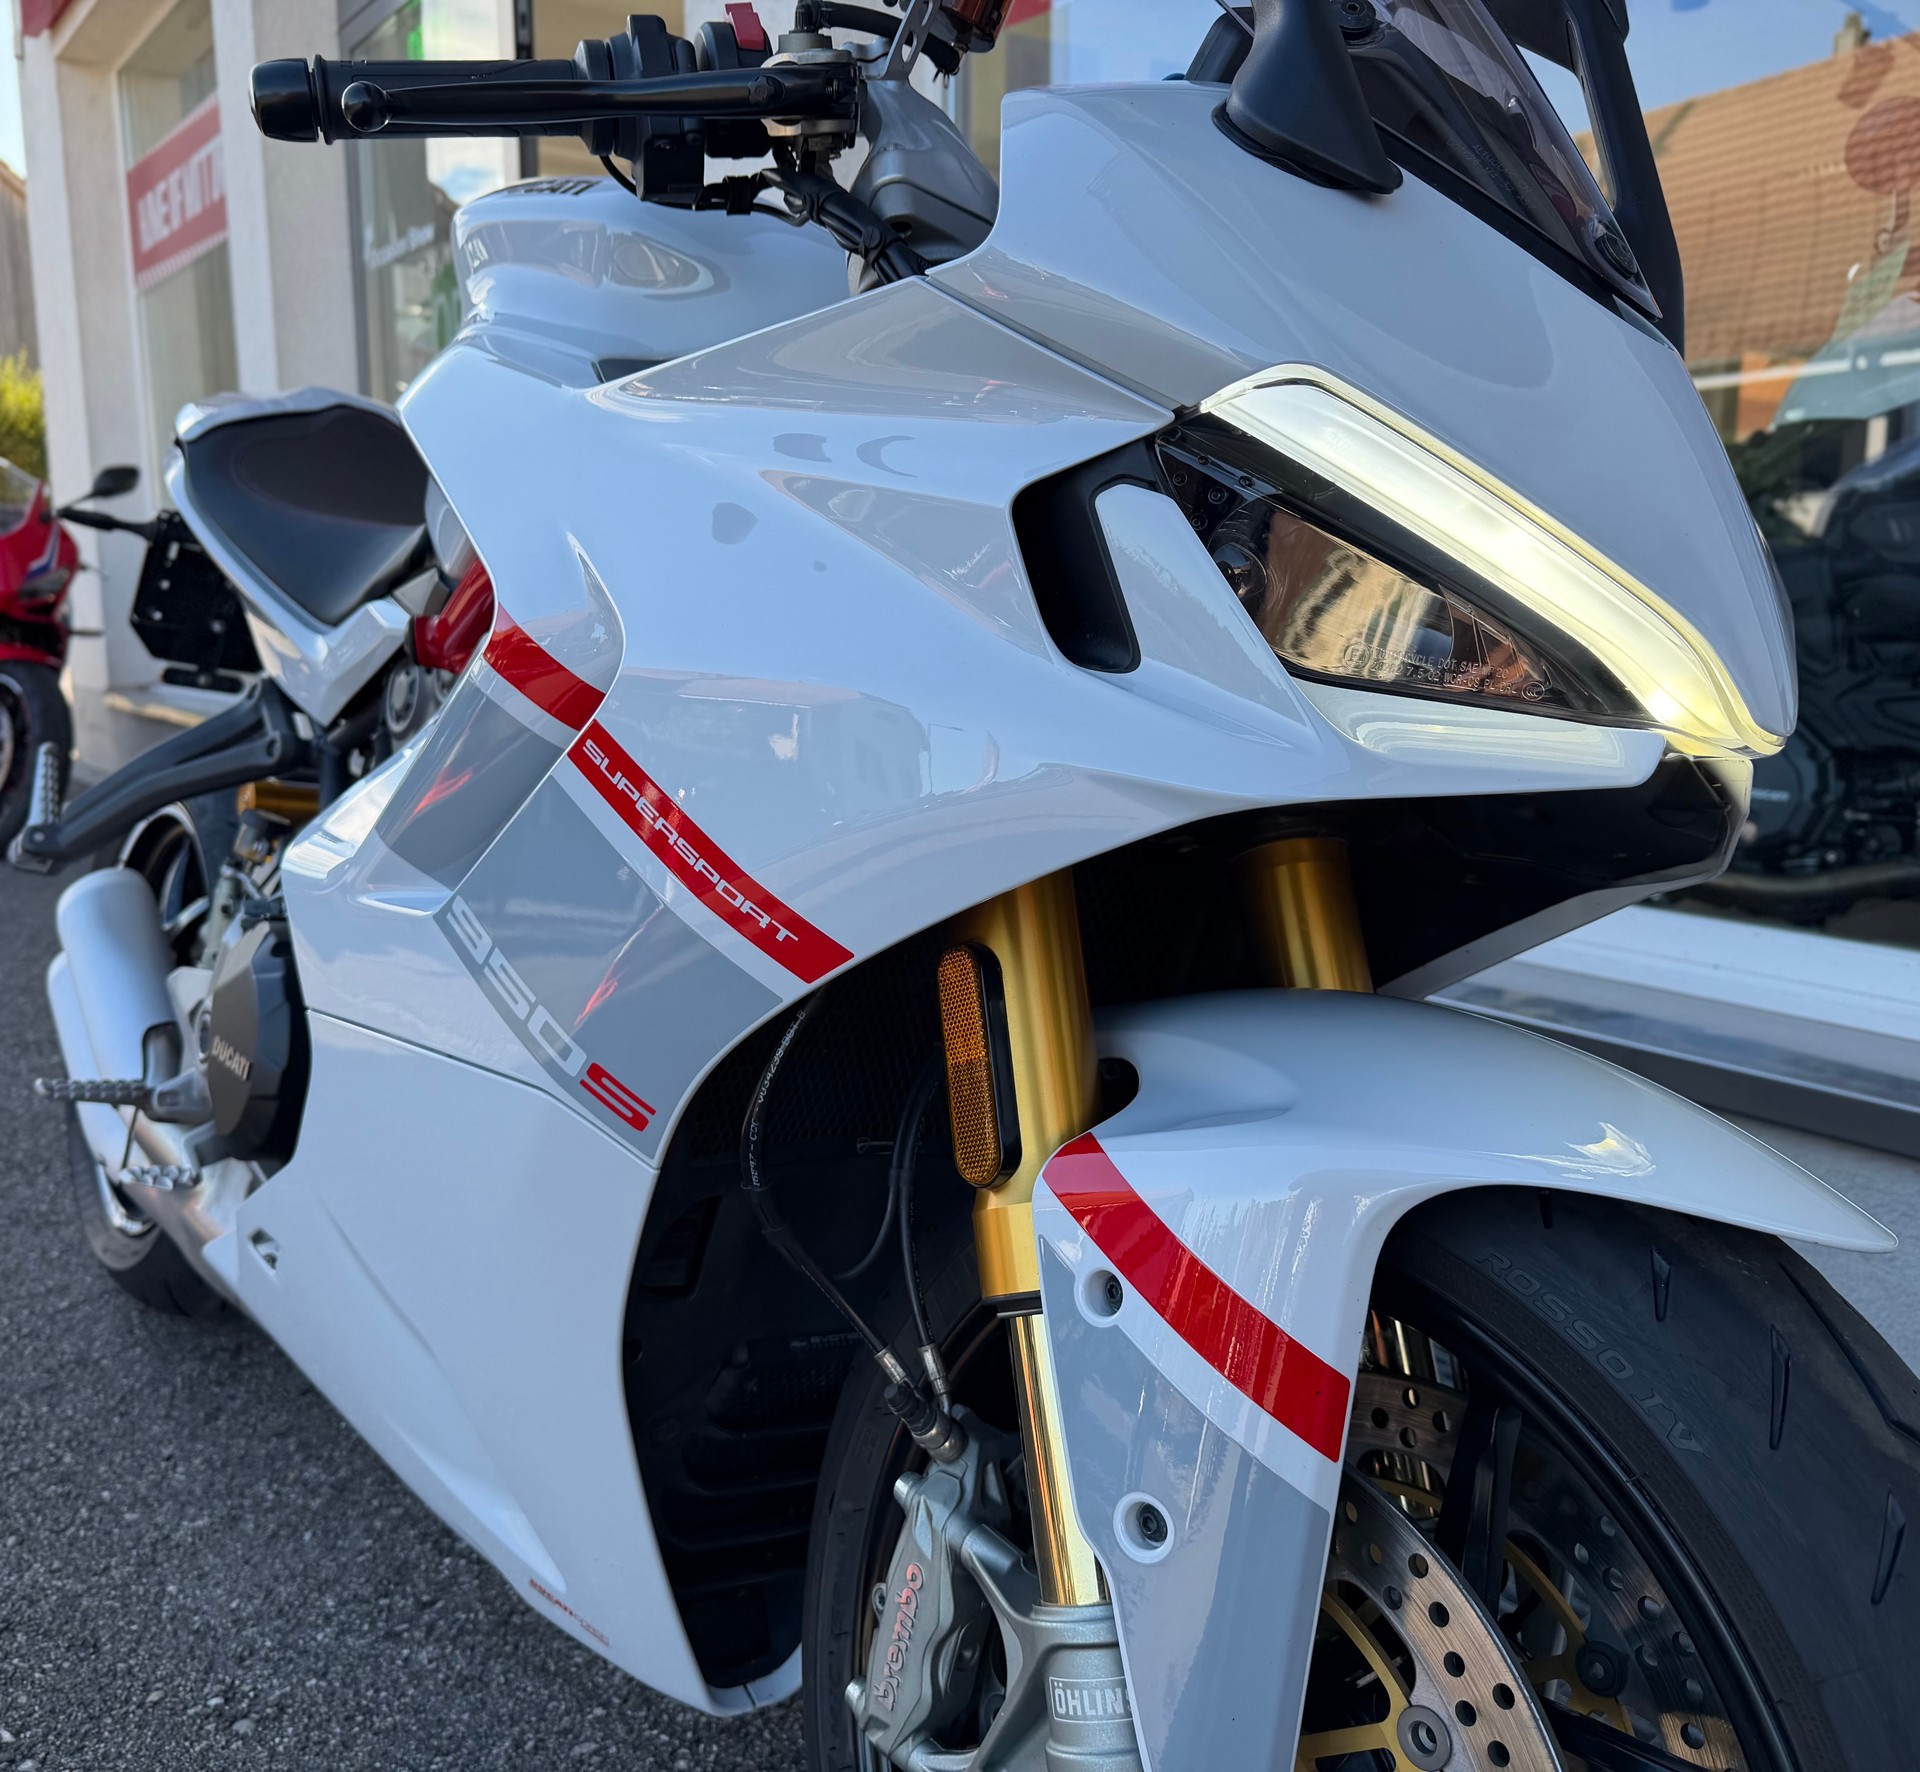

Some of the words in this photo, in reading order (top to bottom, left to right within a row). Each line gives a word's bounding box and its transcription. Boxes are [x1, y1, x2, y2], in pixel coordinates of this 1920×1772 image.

[582, 738, 799, 942] SUPERSPORT
[211, 1035, 251, 1081] DUCATI
[1474, 1247, 1635, 1382] ROSSO
[1629, 1387, 1711, 1461] IV
[873, 1562, 926, 1712] brembo
[1053, 1681, 1132, 1717] ÖHLIN
